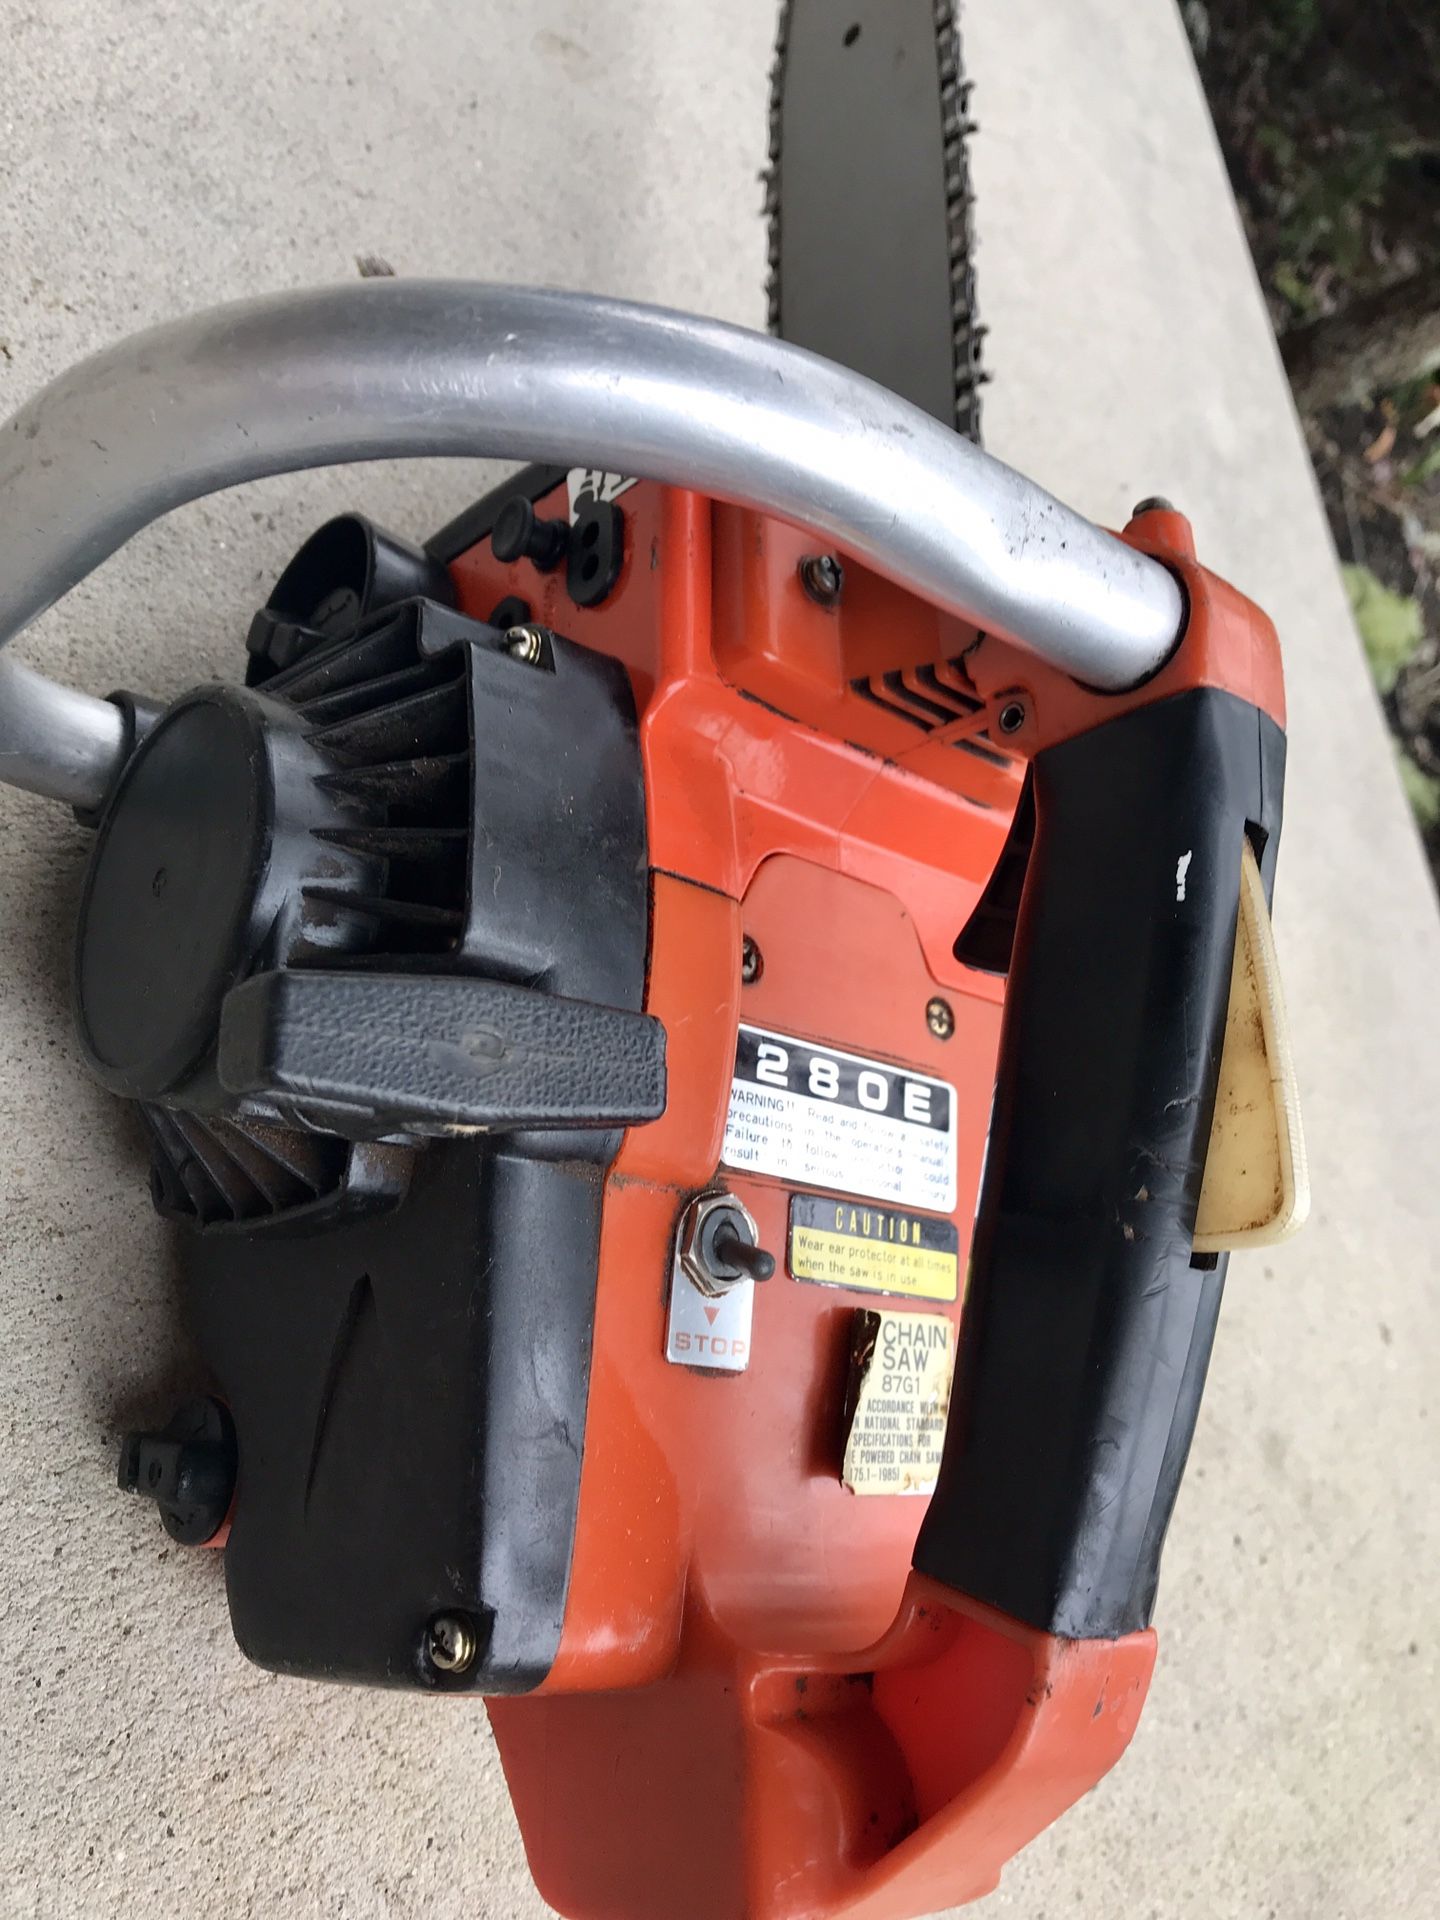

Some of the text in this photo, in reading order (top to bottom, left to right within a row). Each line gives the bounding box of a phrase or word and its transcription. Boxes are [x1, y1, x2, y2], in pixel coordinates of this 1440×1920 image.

[756, 1042, 931, 1124] 280E
[726, 1124, 768, 1145] Failure
[835, 1207, 921, 1244] CAUTION
[798, 1235, 952, 1273] Wear ear protector at all times
[798, 1257, 917, 1286] when the saw is in use
[675, 1331, 746, 1356] STOP
[882, 1320, 947, 1349] CHAIN
[882, 1344, 928, 1372] SAW
[882, 1374, 920, 1395] 87G1
[867, 1399, 914, 1414] ACCORDANCE
[864, 1416, 900, 1430] NATIONAL
[853, 1432, 931, 1447] SPECIFICATIONS FOR
[860, 1450, 895, 1464] POWERED
[900, 1450, 921, 1464] CHAIN
